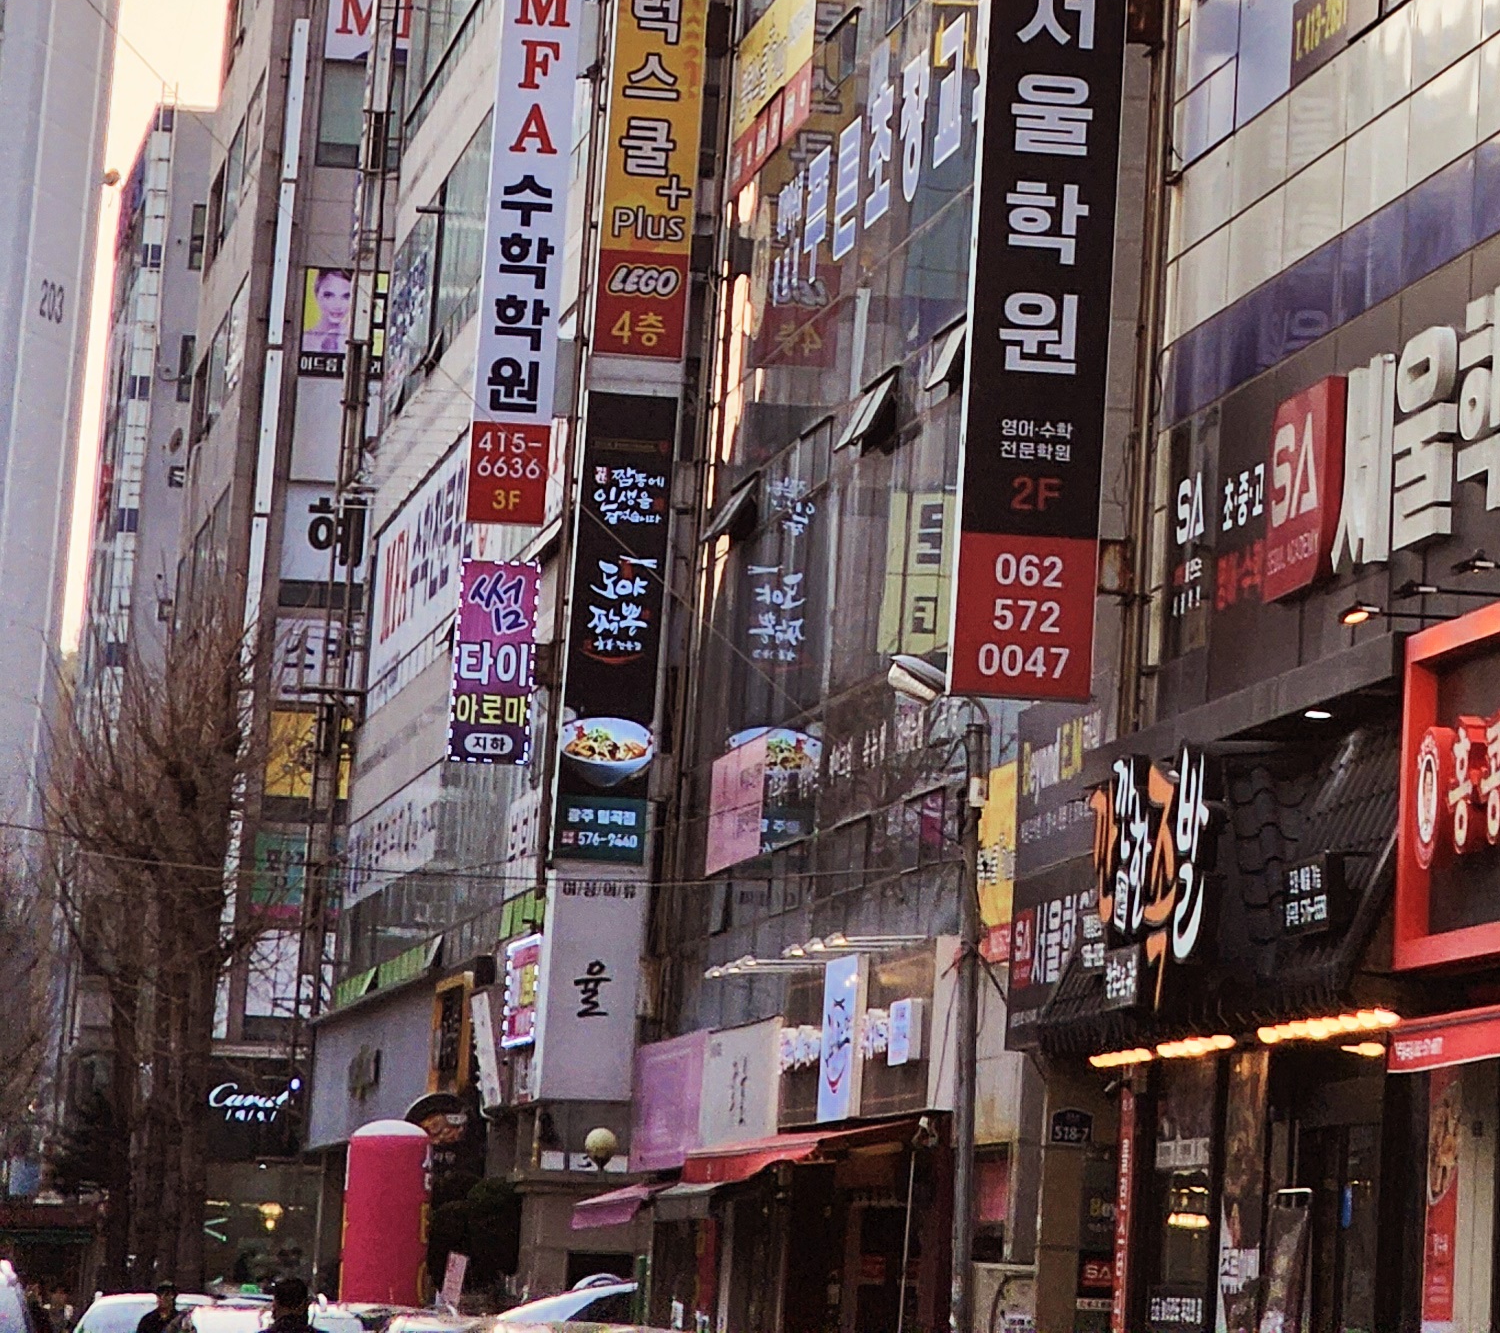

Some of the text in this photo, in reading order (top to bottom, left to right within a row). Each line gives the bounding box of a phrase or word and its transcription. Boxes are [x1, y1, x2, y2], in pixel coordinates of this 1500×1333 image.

[803, 12, 984, 284] 푸른초장교
[611, 206, 684, 243] Plus
[486, 173, 556, 414] 수학학원
[606, 262, 681, 298] LEGO
[39, 278, 65, 326] 203
[610, 312, 667, 348] 4층
[476, 454, 541, 480] 6636
[1000, 440, 1071, 462] 전문학원
[1271, 411, 1318, 529] SA
[491, 489, 522, 510] 3F
[1009, 475, 1061, 512] 2F
[1176, 471, 1205, 545] SA
[994, 552, 1063, 588] 062
[467, 570, 529, 636] 썸
[993, 598, 1060, 633] 572
[459, 641, 529, 688] 타이
[978, 643, 1070, 679] 0047
[456, 693, 527, 728] 아로마
[472, 736, 506, 752] 지하
